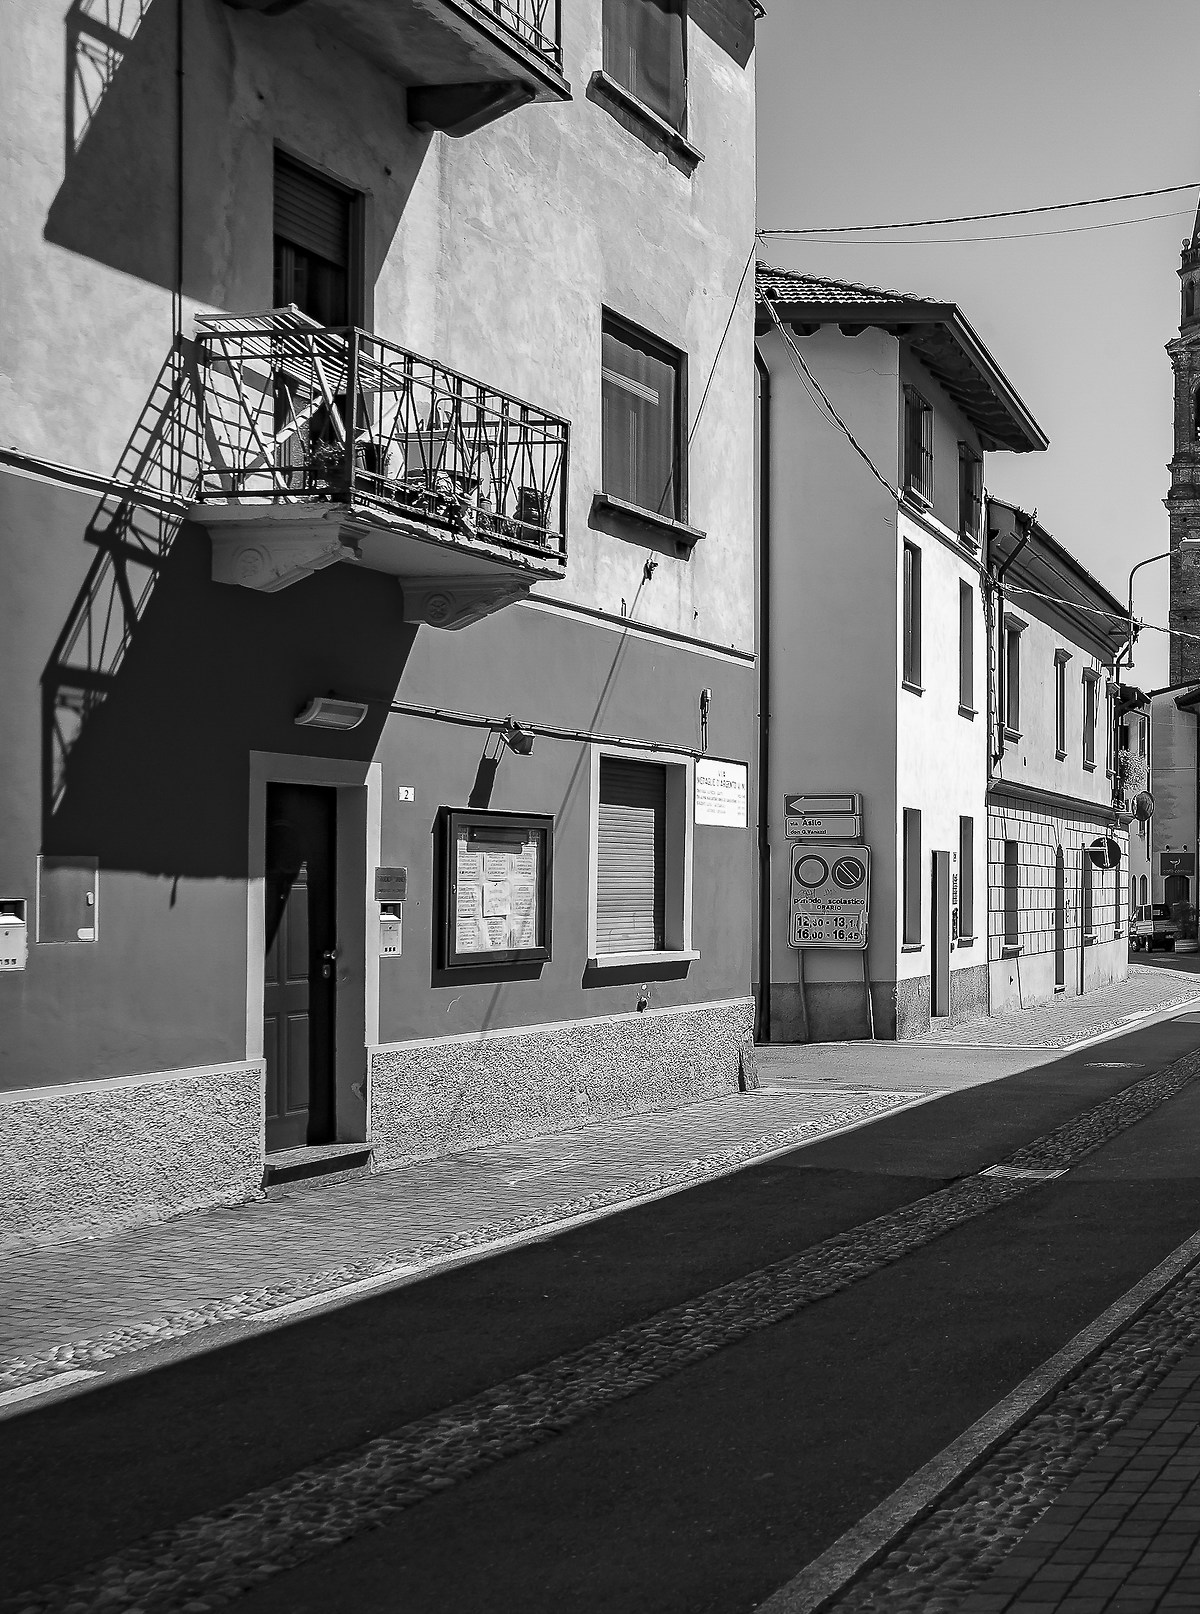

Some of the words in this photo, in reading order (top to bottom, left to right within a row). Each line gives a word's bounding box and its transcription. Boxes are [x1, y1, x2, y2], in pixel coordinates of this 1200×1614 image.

[404, 789, 409, 799] 2
[827, 897, 865, 905] scolastico
[832, 929, 860, 941] 16,45
